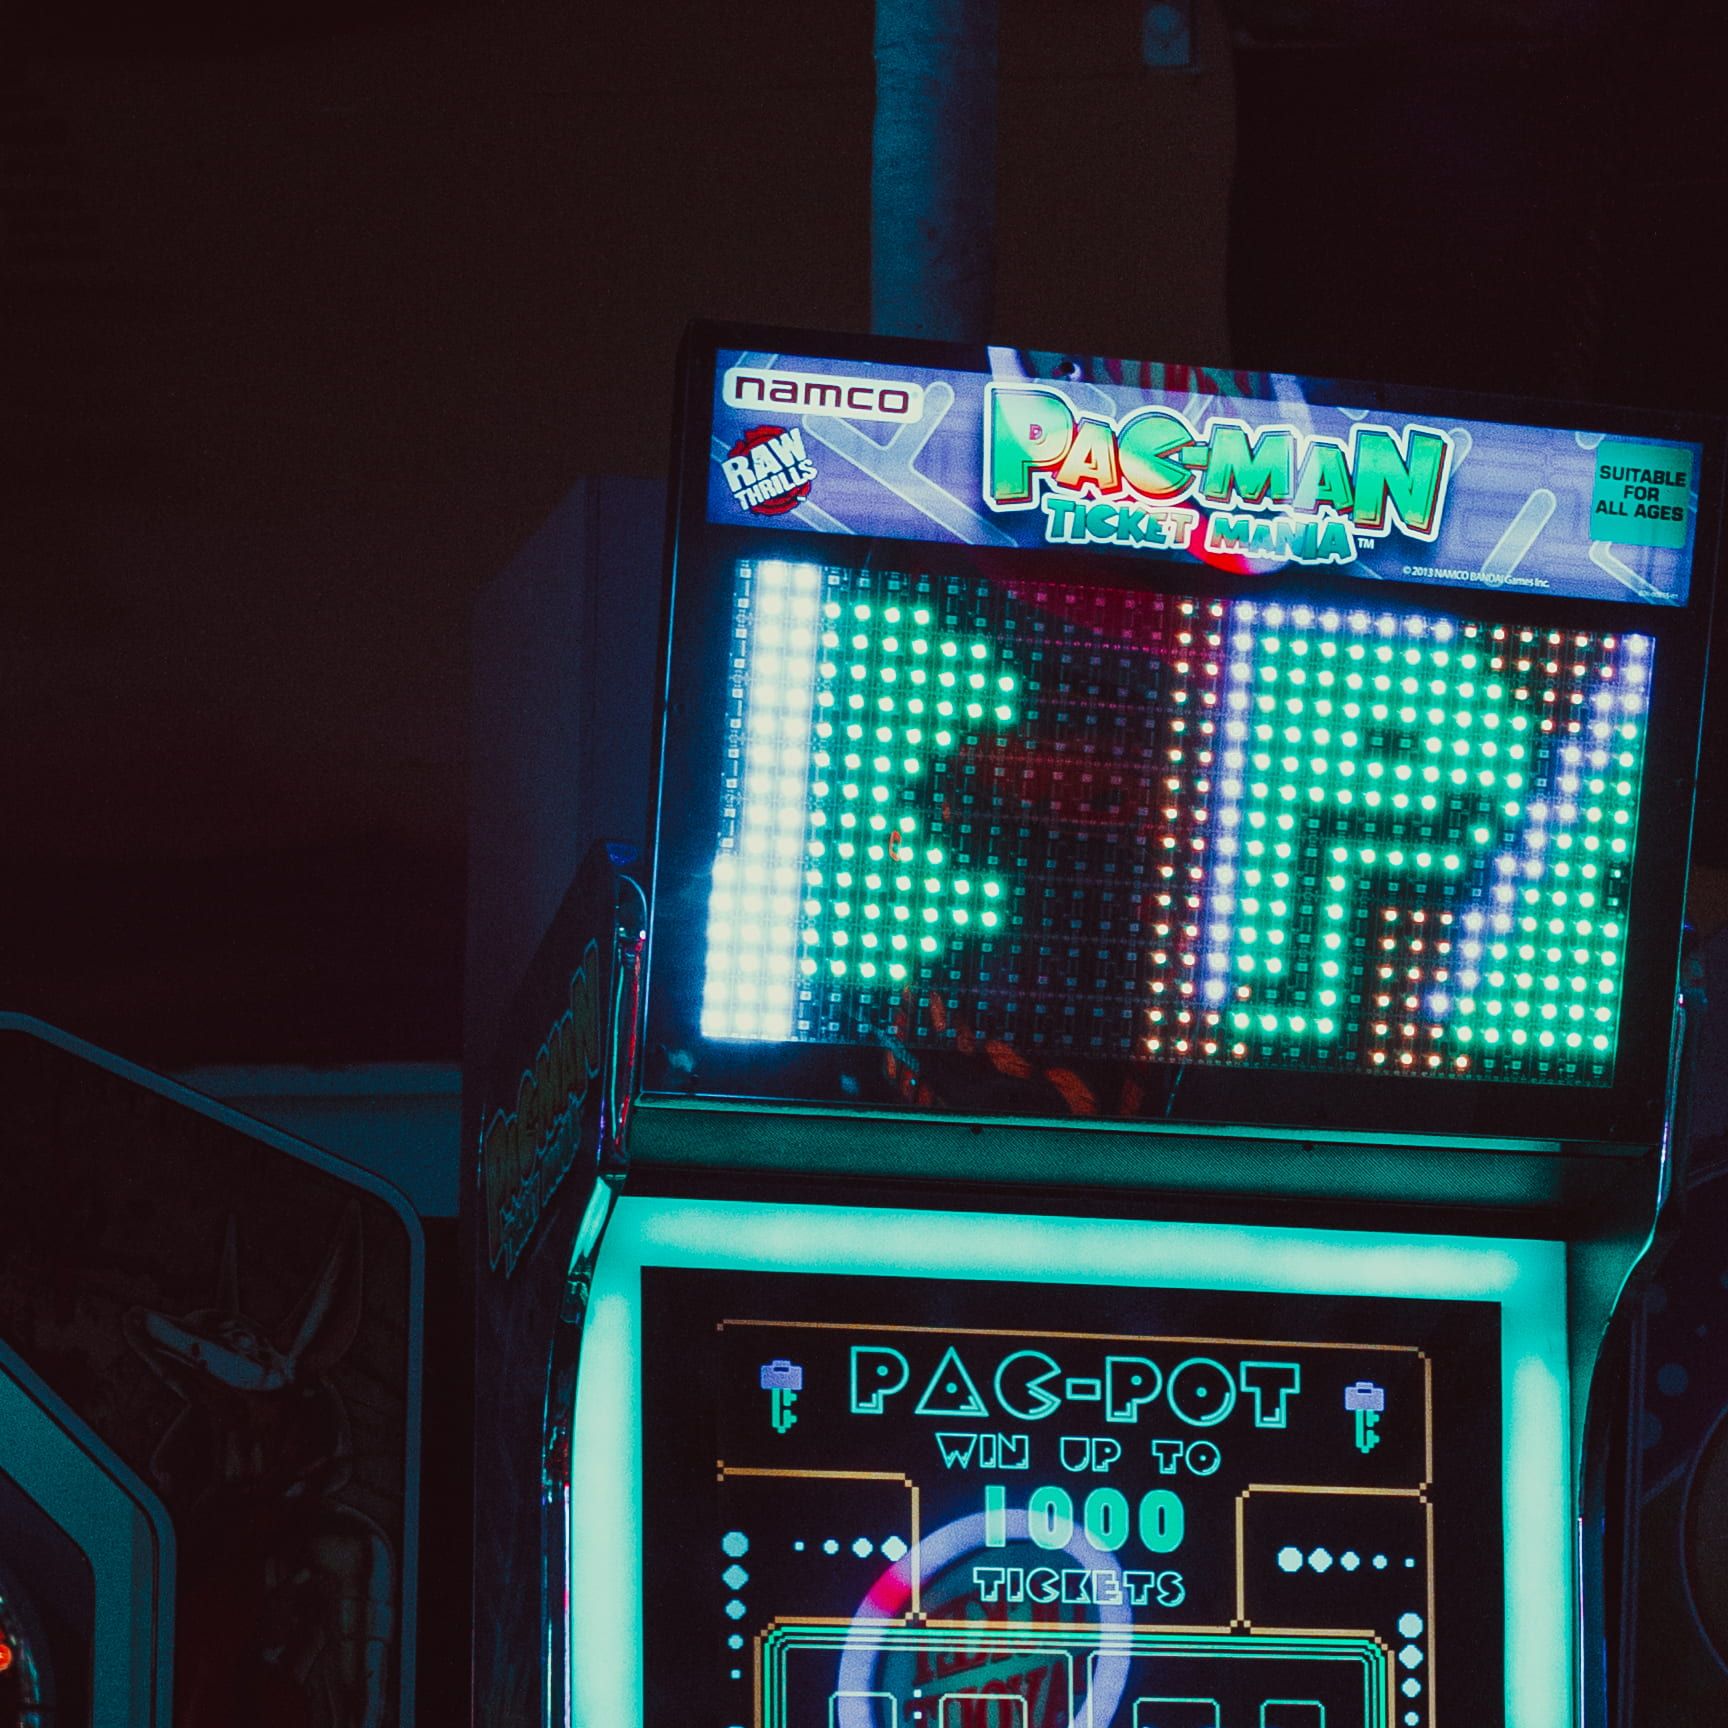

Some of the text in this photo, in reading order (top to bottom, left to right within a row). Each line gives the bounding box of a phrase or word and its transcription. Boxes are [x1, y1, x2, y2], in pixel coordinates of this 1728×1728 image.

[735, 376, 909, 415] namco
[721, 427, 808, 492] RAW
[988, 384, 1449, 537] PAC-MAN
[1600, 465, 1687, 488] SUITABLE
[733, 458, 819, 511] THRILLS
[1623, 485, 1660, 502] FOR
[1046, 498, 1197, 547] TICKET
[1210, 515, 1353, 561] MANIA
[1595, 502, 1685, 522] ALL AGES
[850, 1345, 1301, 1428] PAC-POT
[936, 1433, 1221, 1477] WIN UP TO
[984, 1485, 1185, 1554] 1000
[973, 1566, 1186, 1608] TICKETS
